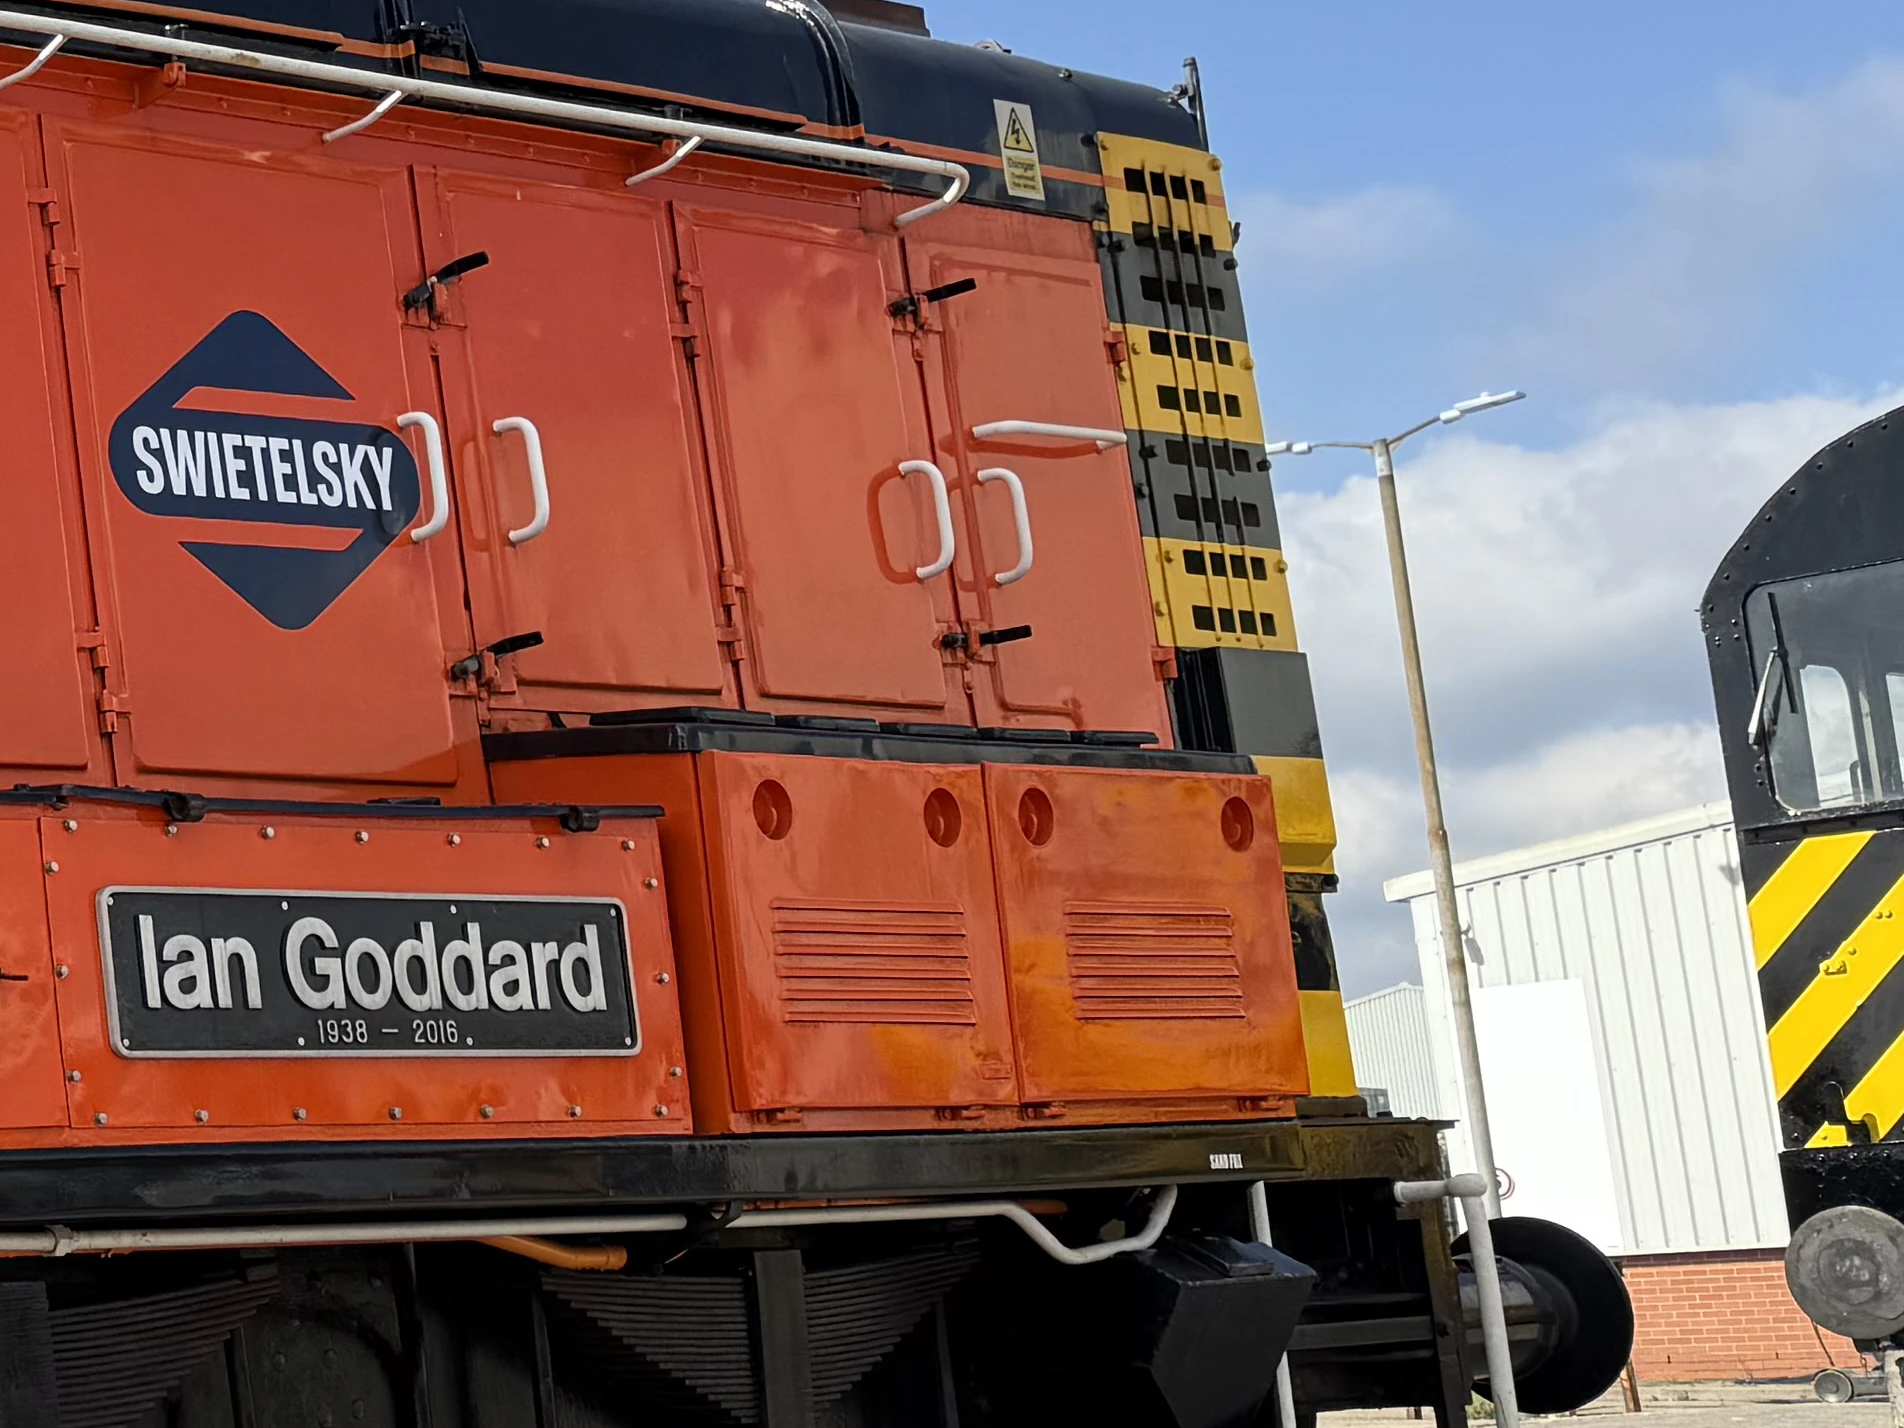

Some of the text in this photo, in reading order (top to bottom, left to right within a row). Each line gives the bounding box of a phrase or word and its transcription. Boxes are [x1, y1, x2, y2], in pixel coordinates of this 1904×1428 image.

[132, 425, 393, 511] SWIETELSKY
[137, 914, 607, 1012] Ian Goddard
[317, 1018, 368, 1044] 1938
[412, 1019, 458, 1045] 2016
